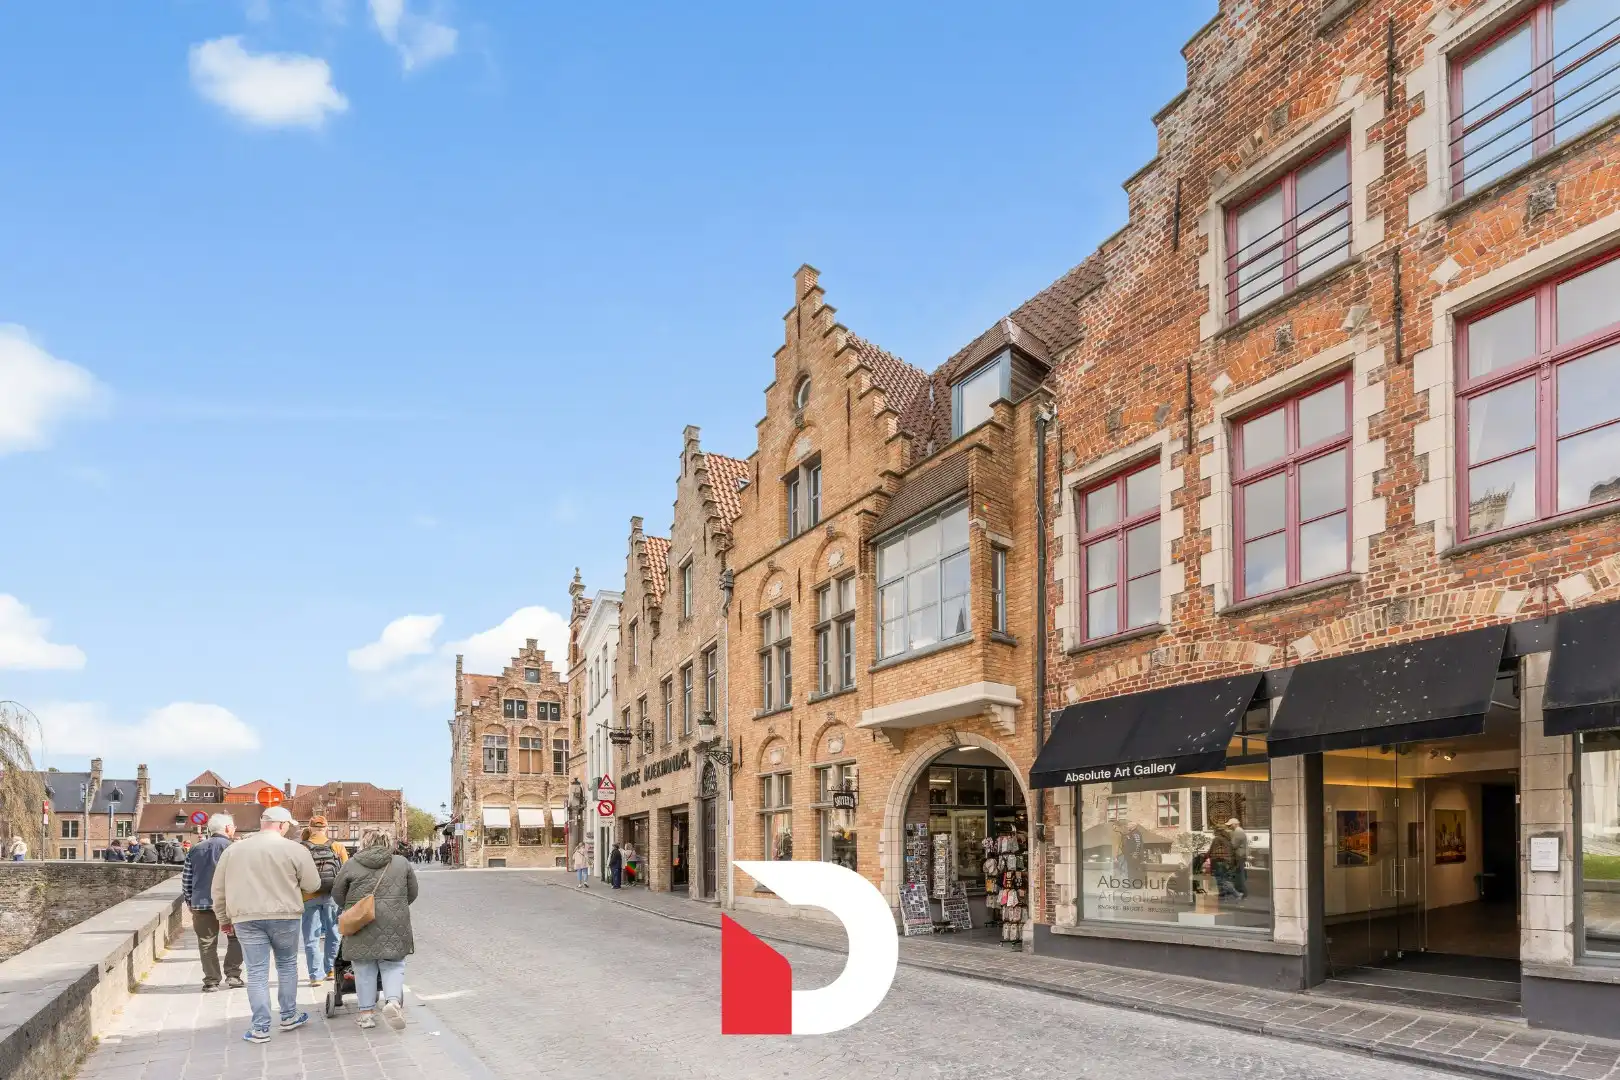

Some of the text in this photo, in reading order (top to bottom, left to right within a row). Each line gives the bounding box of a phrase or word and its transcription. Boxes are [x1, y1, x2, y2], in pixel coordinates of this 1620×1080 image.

[1065, 763, 1176, 783] Absolute Art Gallery
[1097, 875, 1177, 890] Absolute
[1099, 890, 1175, 904] Art Gallery
